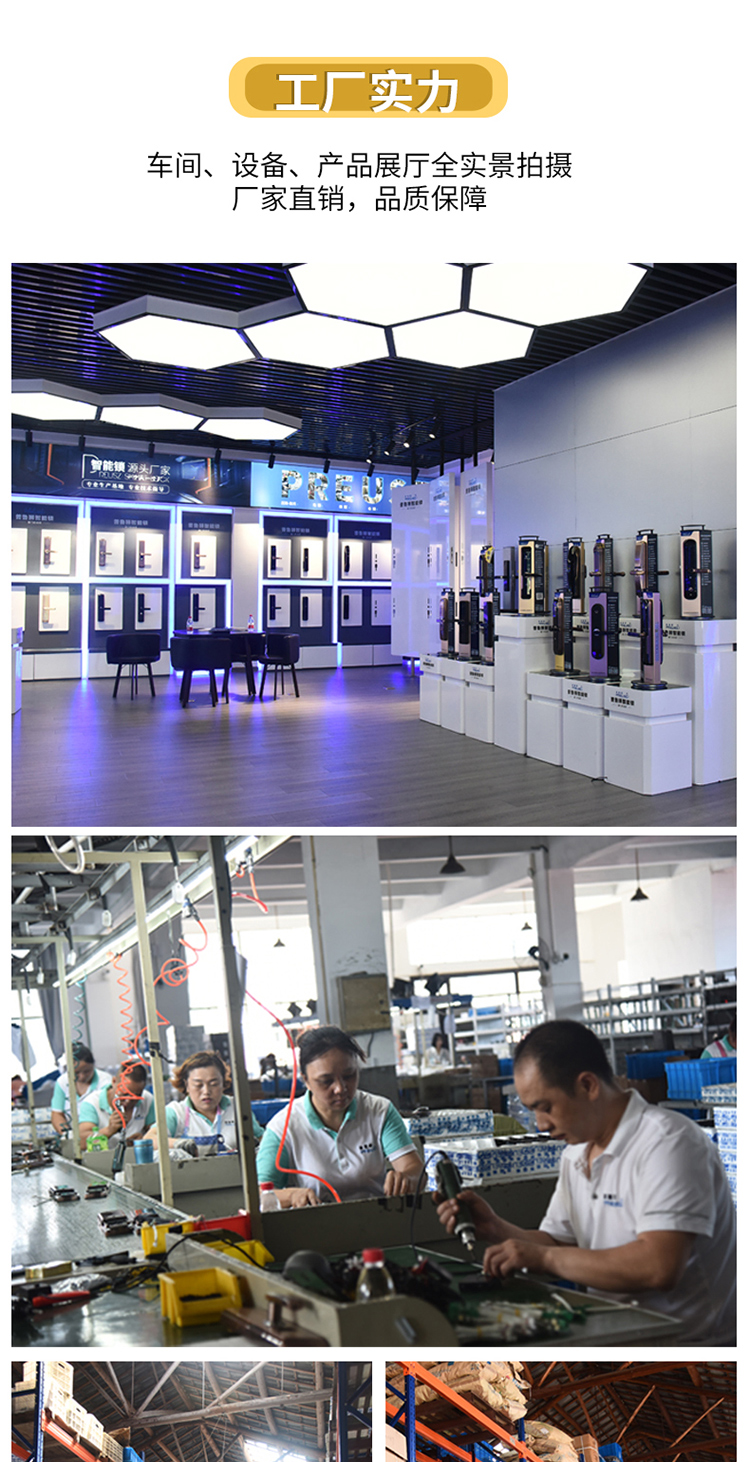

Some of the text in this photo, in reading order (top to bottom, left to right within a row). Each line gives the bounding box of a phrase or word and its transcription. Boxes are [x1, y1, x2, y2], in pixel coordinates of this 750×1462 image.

[90, 459, 171, 476] 智能锁 源头厂家
